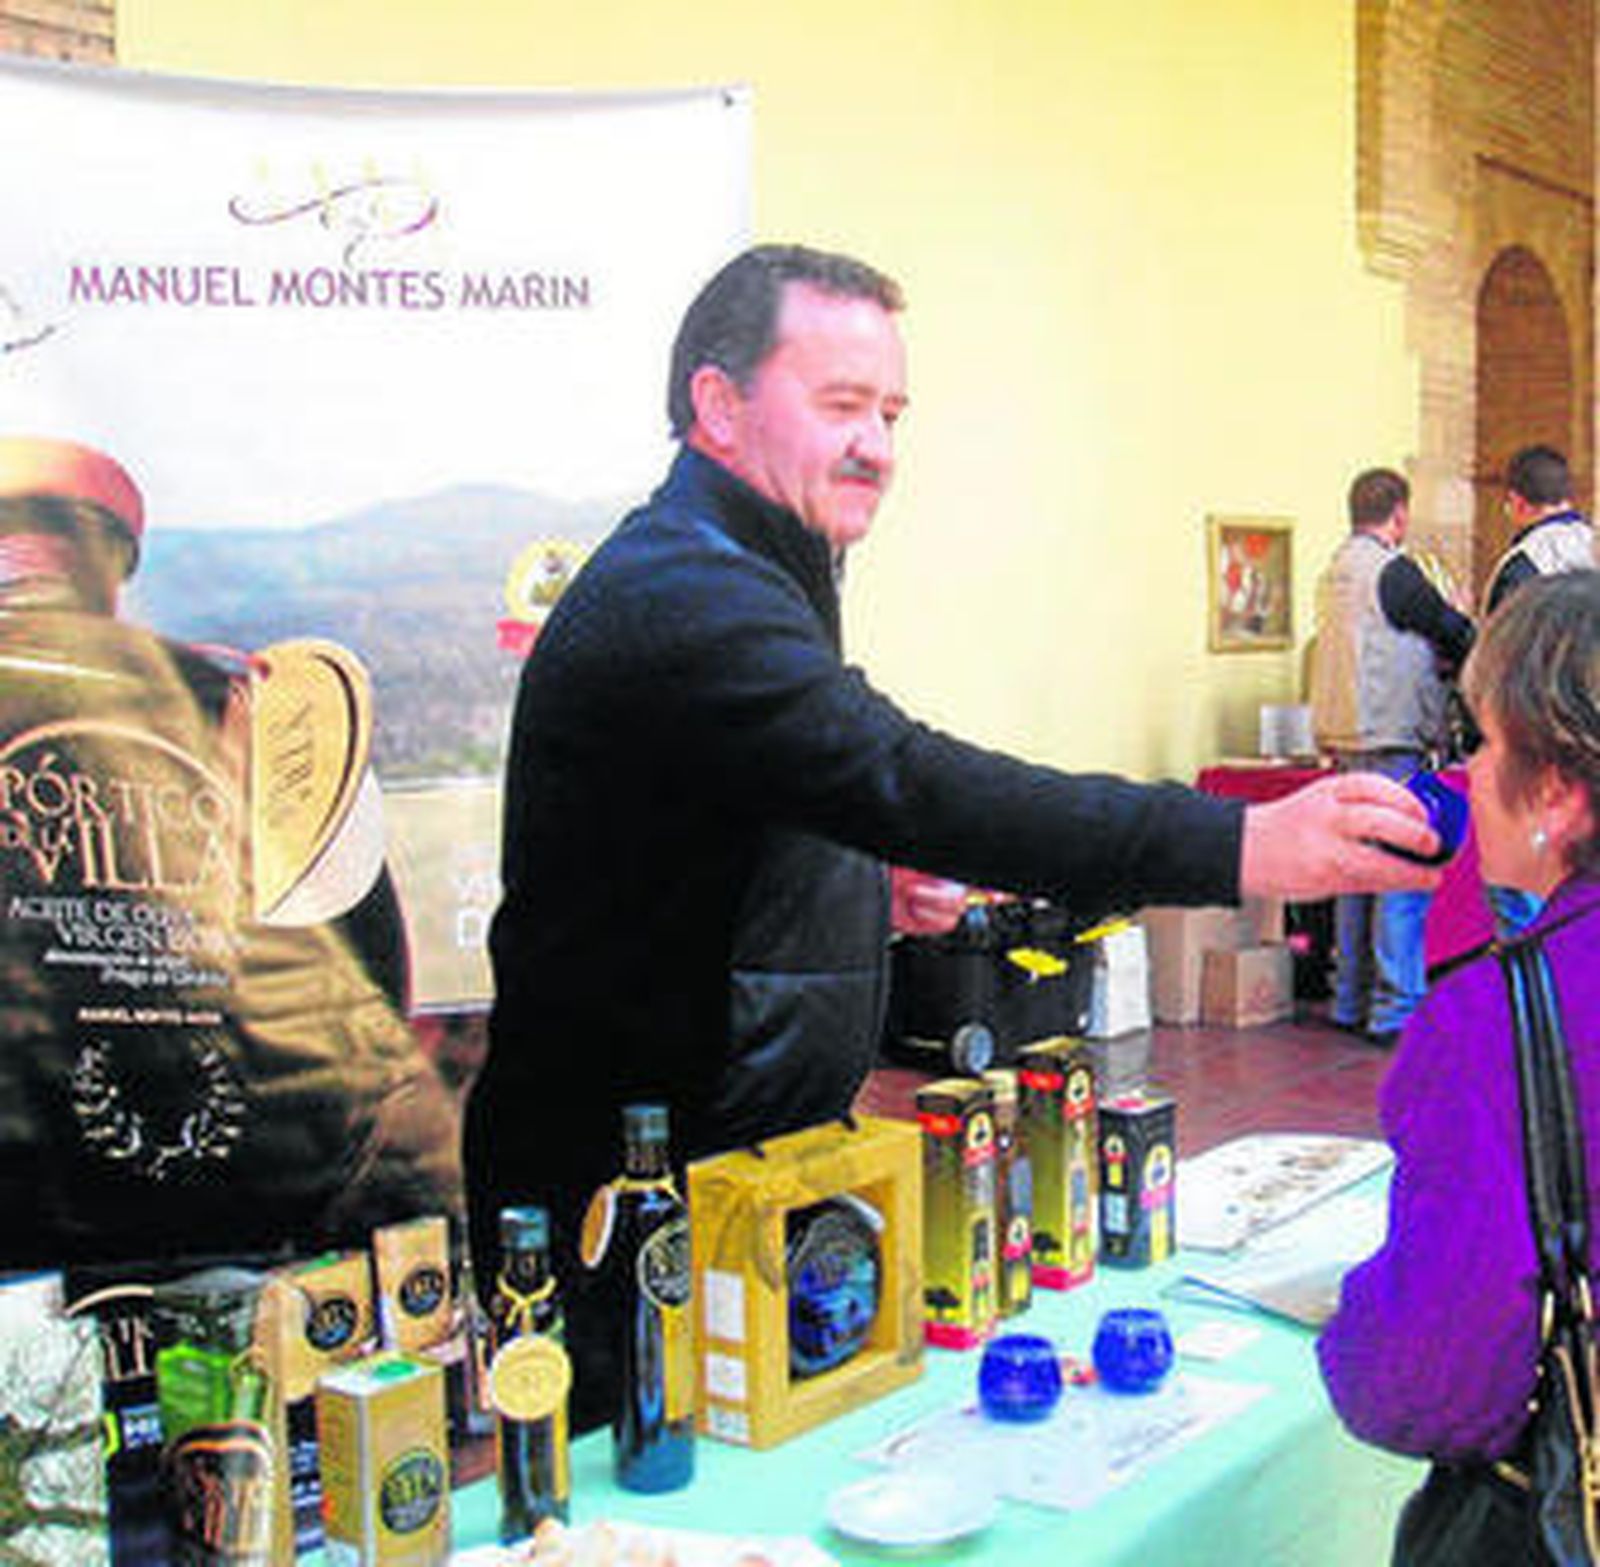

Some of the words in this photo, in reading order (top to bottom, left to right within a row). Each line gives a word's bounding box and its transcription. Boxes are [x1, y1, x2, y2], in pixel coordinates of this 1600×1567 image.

[69, 265, 254, 306] MANUEL
[268, 269, 445, 310] MONTES
[459, 275, 592, 309] MARIN
[0, 754, 224, 828] PÓRTICO
[25, 815, 238, 892] VILLA
